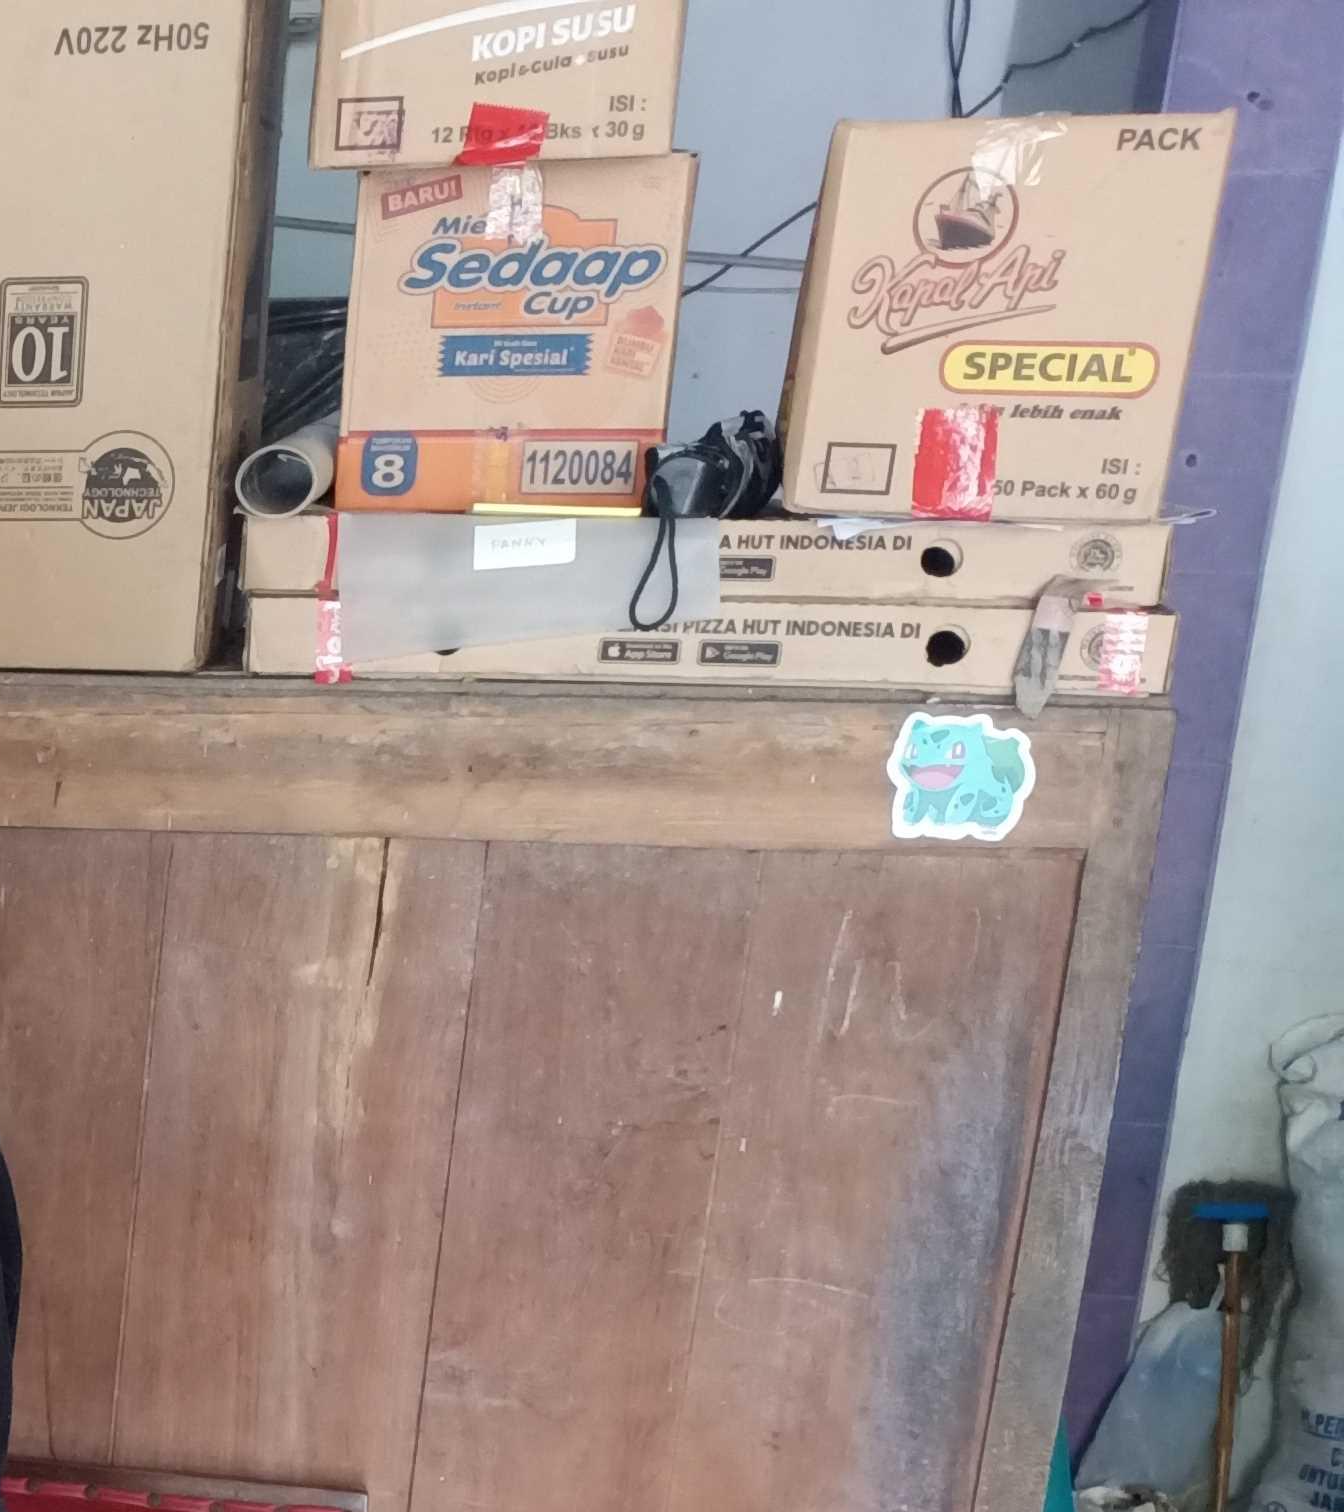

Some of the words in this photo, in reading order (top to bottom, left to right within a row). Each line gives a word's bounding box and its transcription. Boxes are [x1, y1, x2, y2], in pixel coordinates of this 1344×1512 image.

[54, 26, 128, 56] 220V
[137, 22, 210, 52] 50Hz
[471, 22, 545, 62] KOPI
[551, 3, 637, 43] SUSU
[474, 63, 515, 86] Kopi
[609, 95, 635, 112] ISI
[432, 126, 453, 144] 12
[545, 122, 582, 139] Bks
[605, 122, 629, 140] 30
[632, 122, 645, 141] g
[1116, 127, 1203, 151] PACK
[387, 180, 459, 212] BARU!
[431, 215, 488, 236] Mie
[403, 238, 664, 299] Sedaap
[847, 252, 978, 337] Kapal
[970, 244, 1066, 311] Api
[523, 291, 595, 320] Cup
[14, 315, 70, 325] YEARS
[11, 326, 69, 382] 10
[454, 350, 494, 367] Kari
[499, 350, 570, 370] Spesial
[962, 351, 1133, 383] SPECIAL
[1010, 403, 1064, 420] lebih
[1069, 404, 1123, 421] enak
[371, 454, 404, 488] 8
[526, 450, 632, 486] 1120084
[1101, 458, 1129, 474] ISI
[84, 487, 161, 499] TECHNOLOGY
[1020, 480, 1068, 498] Pack
[1075, 484, 1089, 498] x
[1095, 483, 1121, 500] 60
[1123, 488, 1137, 504] g
[83, 498, 163, 520] JAPAN
[737, 534, 773, 550] HUT
[780, 534, 886, 551] INDONESIA
[892, 536, 912, 551] DI
[682, 619, 737, 635] PIZZA
[742, 620, 781, 635] HUT
[786, 621, 895, 638] INDONESIA
[901, 623, 921, 638] DI
